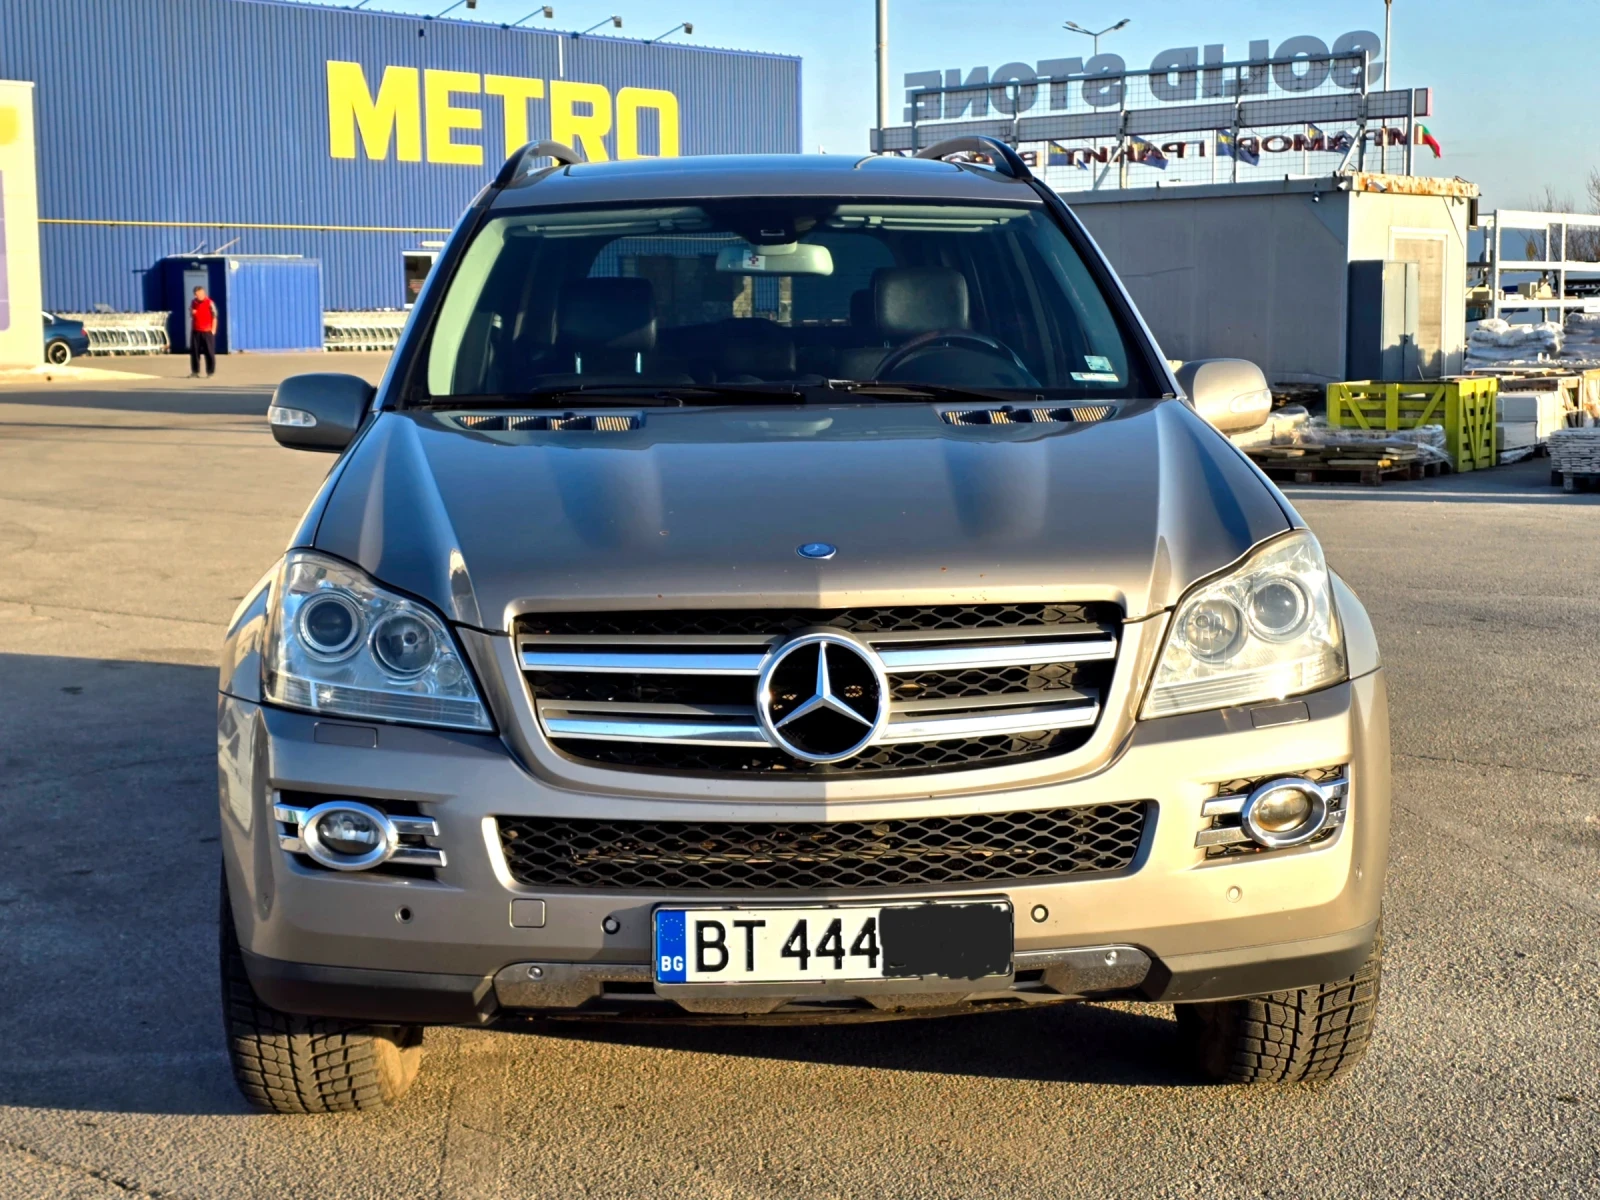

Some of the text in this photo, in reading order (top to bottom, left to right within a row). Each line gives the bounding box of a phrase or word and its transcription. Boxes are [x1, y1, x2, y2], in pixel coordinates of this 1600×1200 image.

[326, 60, 680, 166] METRO
[661, 955, 684, 972] BG
[695, 919, 766, 973] BT
